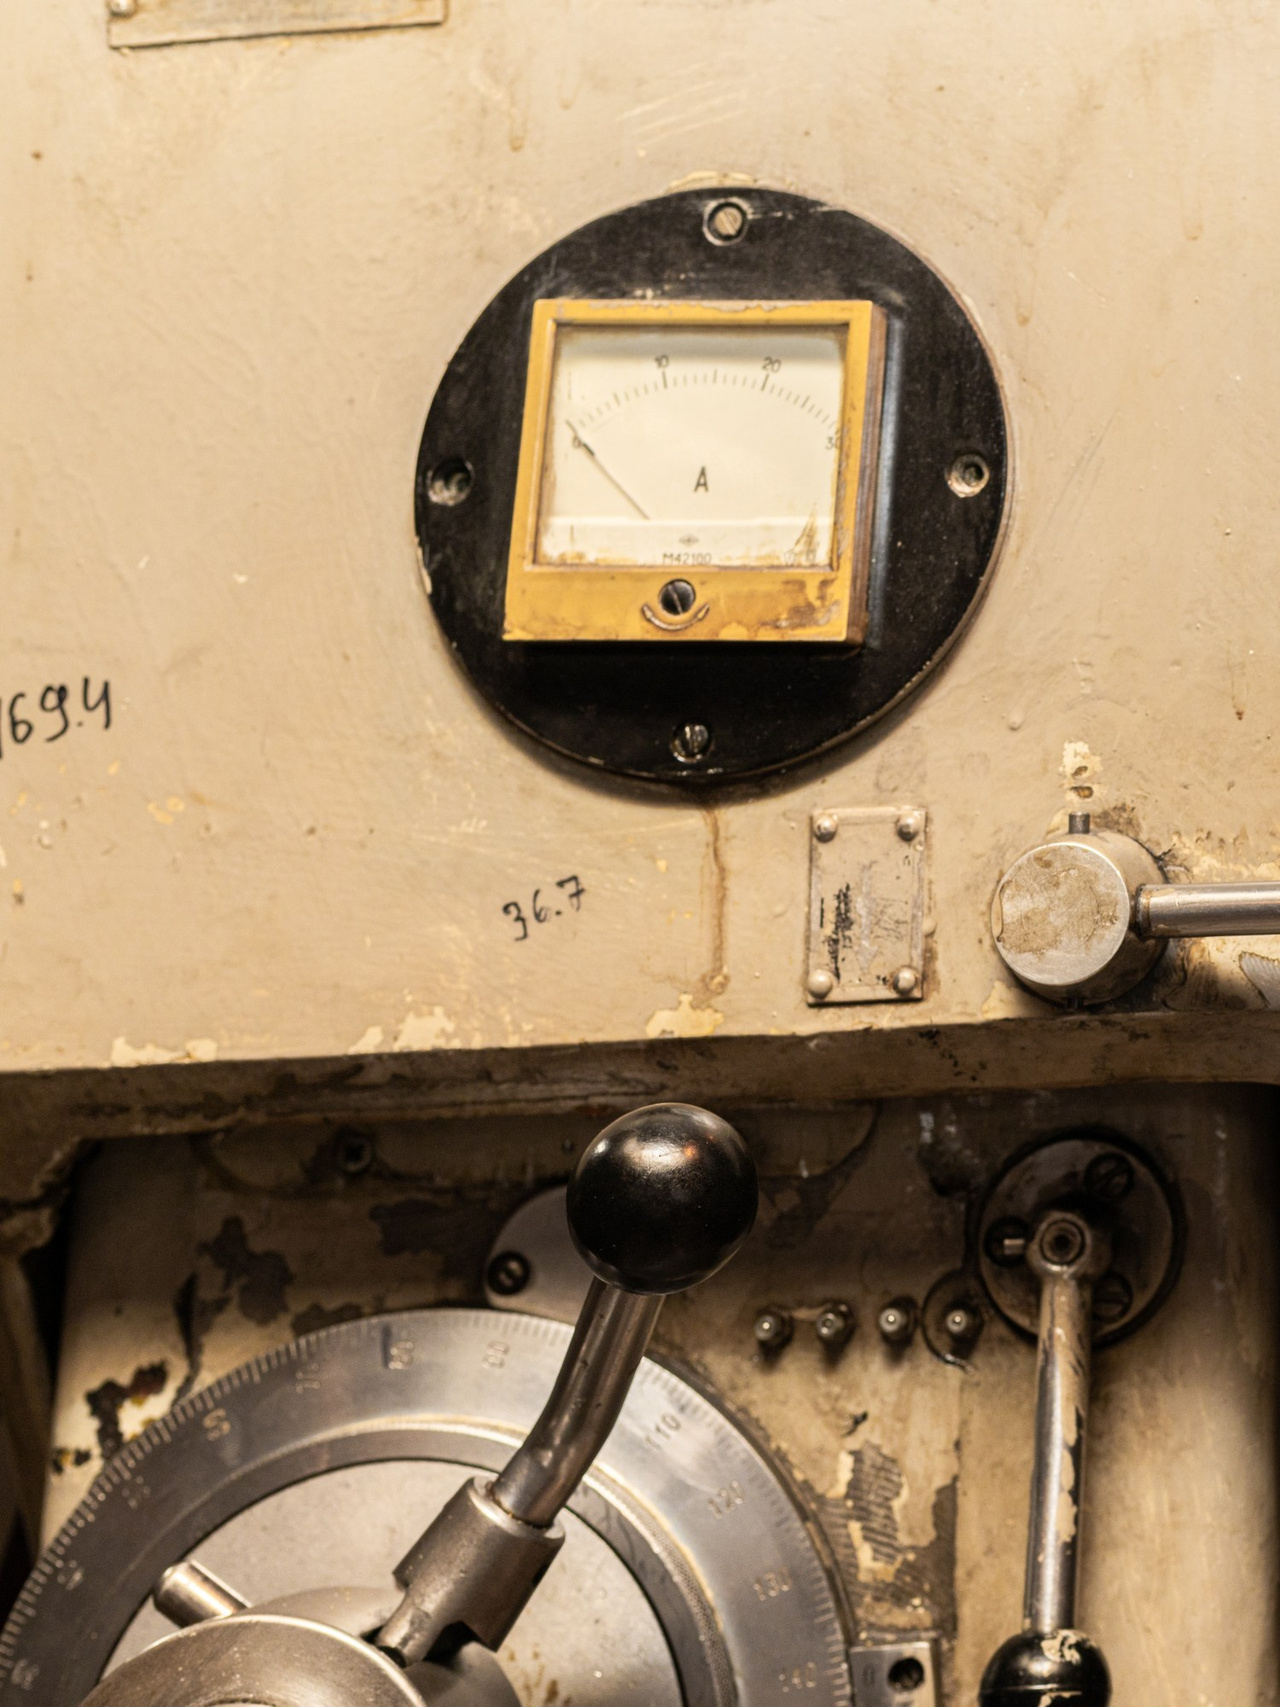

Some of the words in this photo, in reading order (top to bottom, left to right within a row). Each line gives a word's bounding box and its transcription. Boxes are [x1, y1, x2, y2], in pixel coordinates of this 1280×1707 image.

[654, 354, 670, 369] 10
[762, 356, 782, 373] 20
[693, 466, 709, 493] A
[502, 873, 586, 942] 36.7
